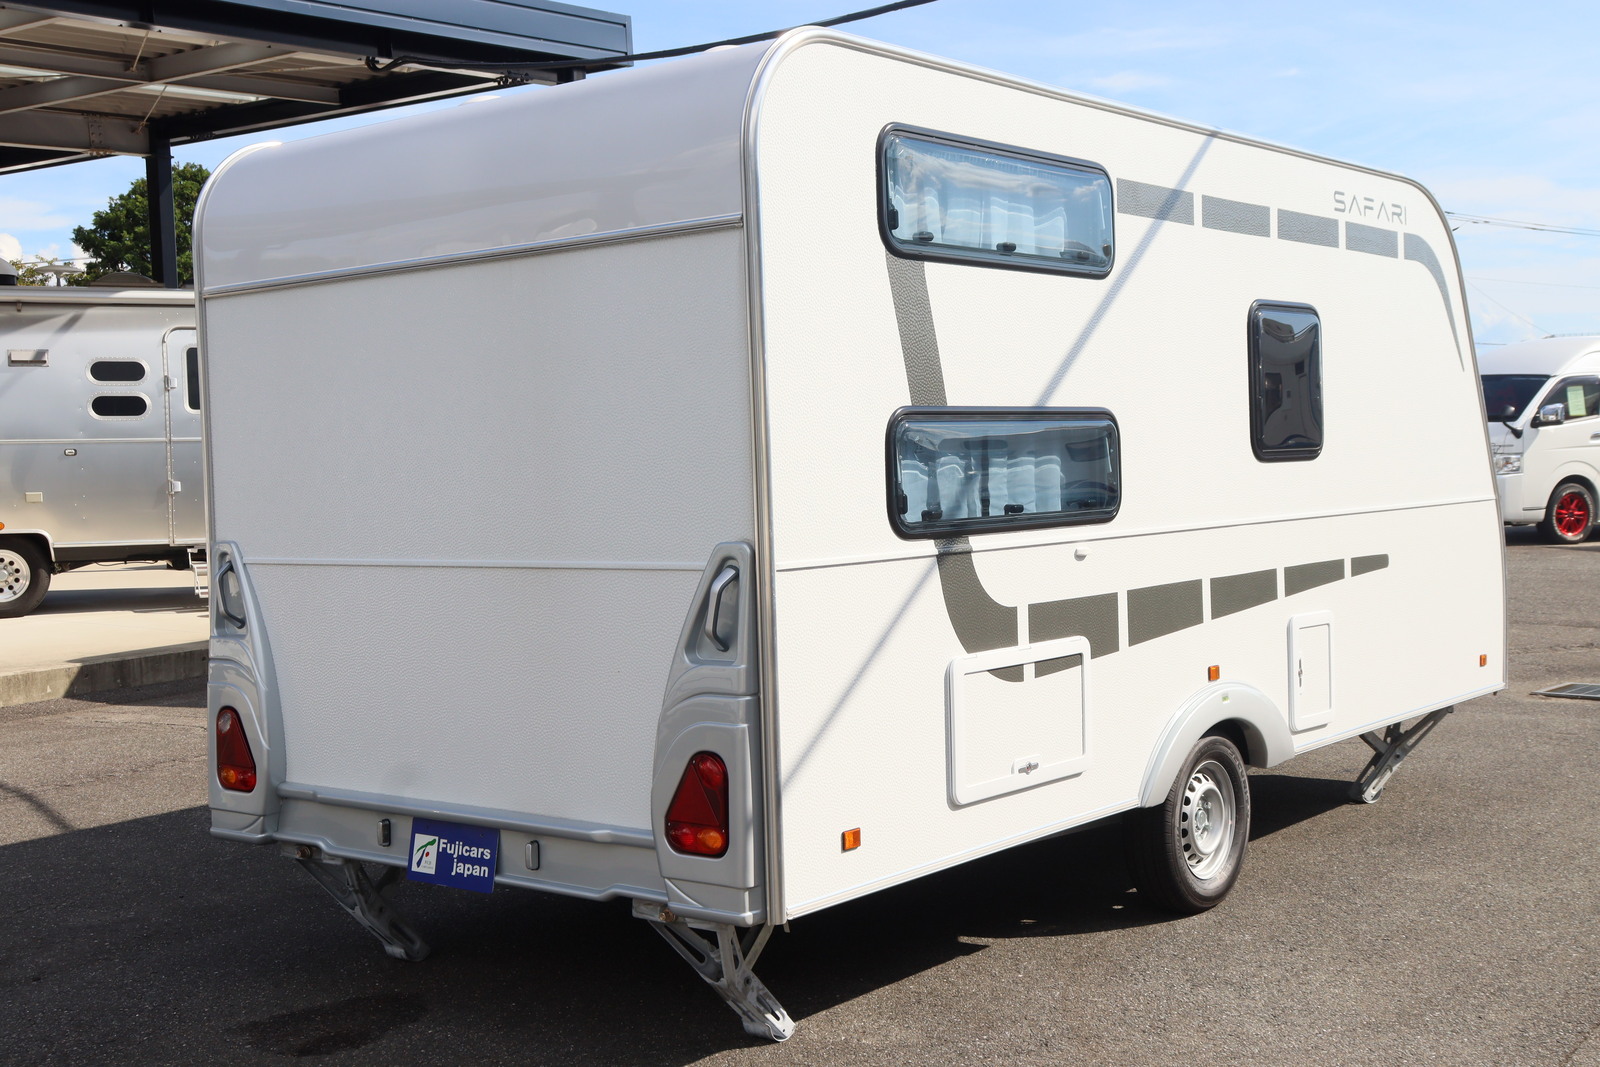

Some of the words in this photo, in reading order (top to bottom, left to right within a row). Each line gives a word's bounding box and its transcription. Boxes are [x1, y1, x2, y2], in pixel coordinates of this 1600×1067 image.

[1334, 190, 1407, 225] SAFARI
[439, 838, 491, 859] Fujicars
[451, 859, 489, 878] japan
